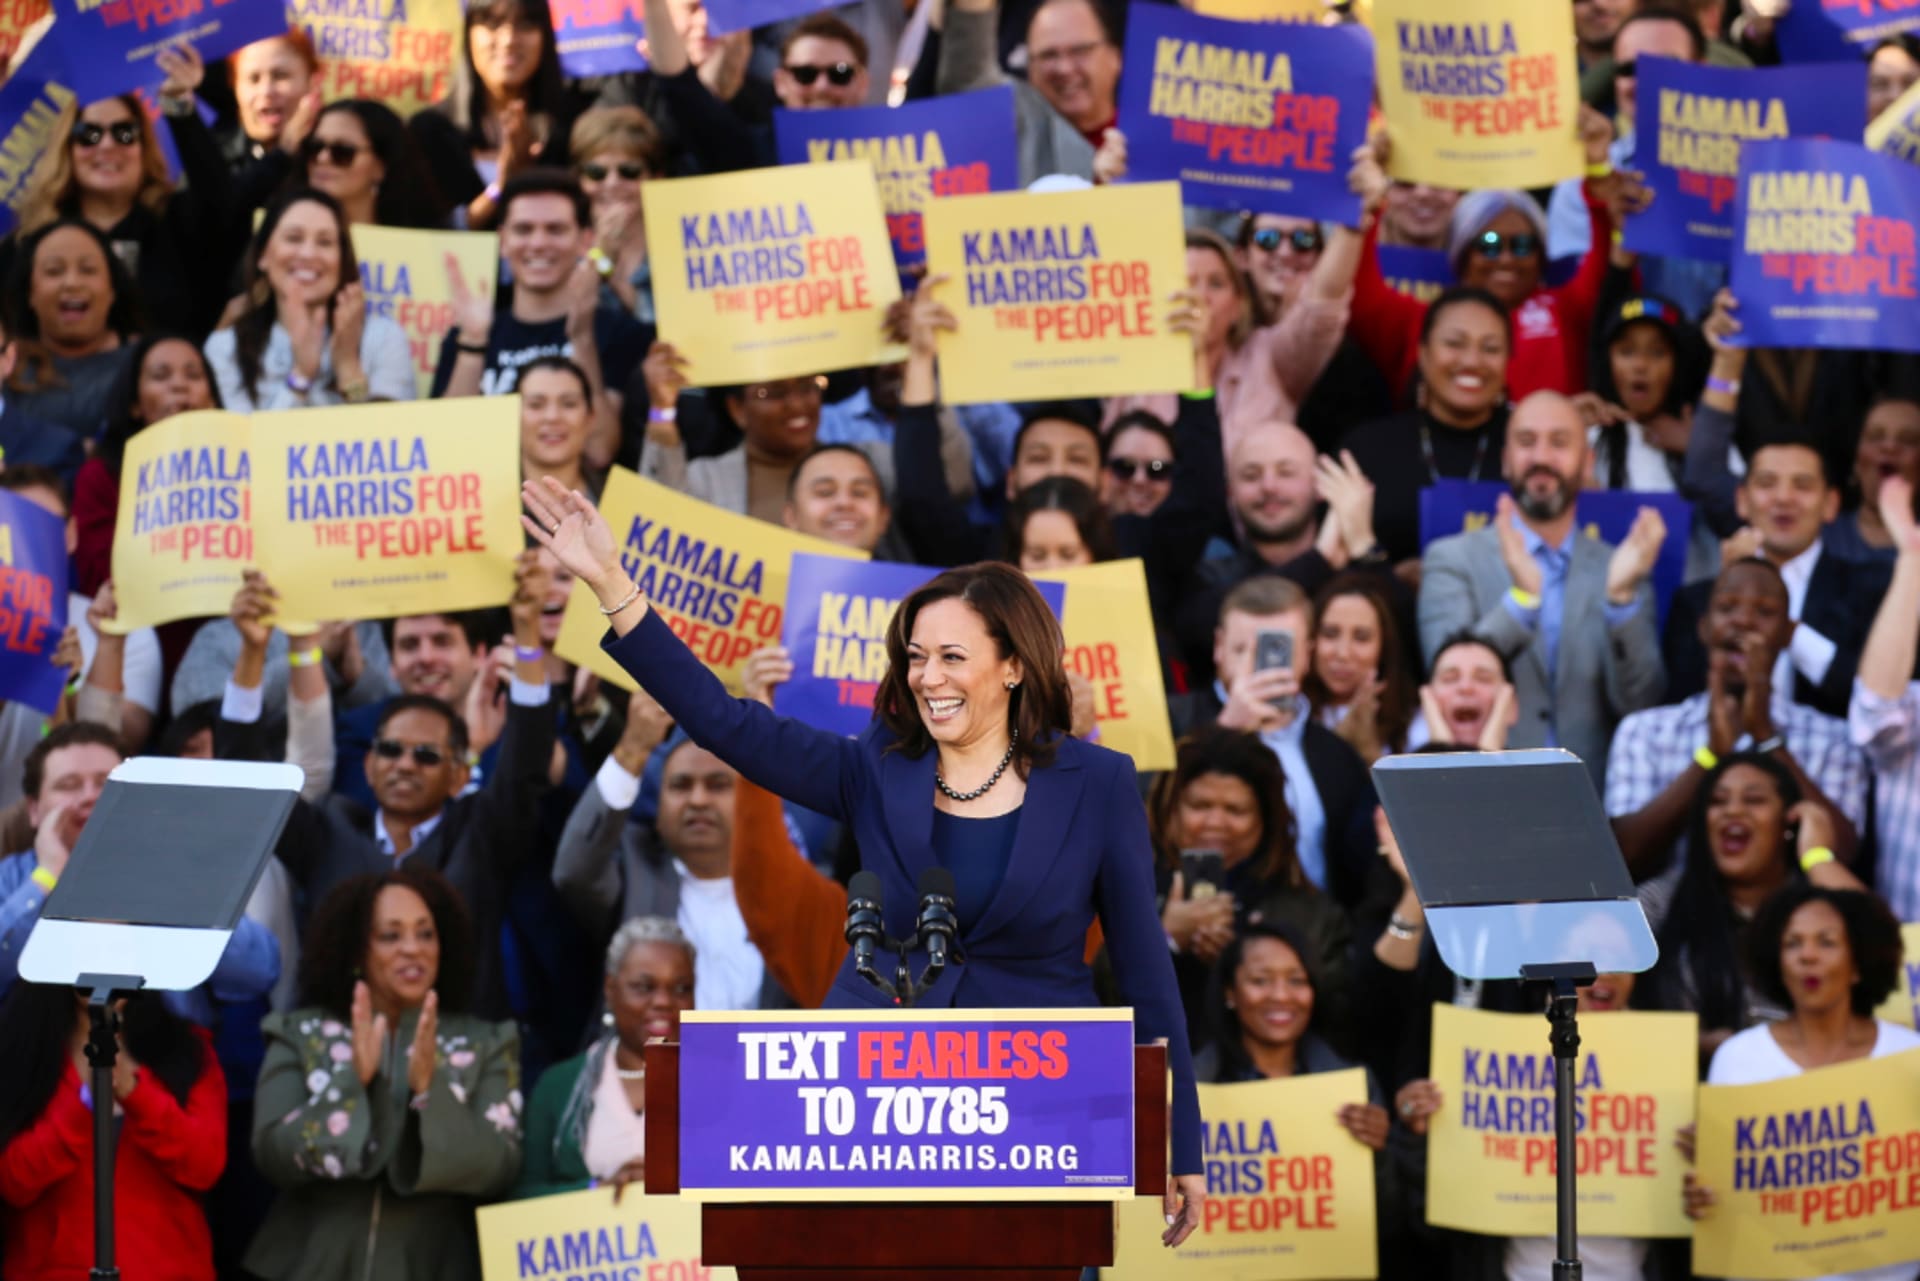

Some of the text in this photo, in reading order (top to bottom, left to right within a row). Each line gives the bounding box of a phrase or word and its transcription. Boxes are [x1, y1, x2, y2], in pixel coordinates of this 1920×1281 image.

[393, 26, 453, 65] FOR
[1397, 20, 1518, 58] KAMALA
[1156, 36, 1294, 95] KAMALA
[1402, 53, 1558, 97] HARRIS FOR
[1150, 77, 1340, 134] HARRIS FOR
[1452, 92, 1562, 137] PEOPLE
[1658, 86, 1789, 140] KAMALA
[1208, 123, 1336, 173] PEOPLE
[1657, 130, 1740, 176] HARR
[1748, 170, 1873, 219] KAMALA
[681, 201, 815, 251] KAMALA
[962, 223, 1099, 267] KAMALA
[1744, 213, 1856, 257] HARRIS
[1856, 215, 1916, 258] FOR
[685, 235, 866, 291] HARRIS FOR
[967, 260, 1151, 306] HARRIS FOR
[1792, 252, 1918, 299] PEOPLE
[712, 273, 873, 325] THE PEOPLE
[993, 299, 1157, 343] THE PEOPLE
[136, 444, 251, 498] KAMALA
[287, 435, 429, 480] KAMALA
[133, 485, 240, 538] HARRIS
[287, 477, 415, 522] HARRIS
[417, 472, 482, 514] FOR
[182, 522, 253, 563] PEO
[312, 513, 487, 560] THE PEOPLE
[626, 513, 765, 597] KAMALA
[620, 551, 784, 640] HARRIS FO
[816, 590, 901, 643] KAM
[667, 613, 765, 669] PEOP
[811, 633, 894, 683] HAR
[738, 1030, 1069, 1080] TEXT FEARLESS
[1463, 1048, 1603, 1091] KAMAA
[797, 1085, 1009, 1136] TO 70785
[1589, 1093, 1658, 1134] FOR
[1736, 1097, 1876, 1152] KAMALA
[729, 1144, 1079, 1172] KAMALAHARRIS.ORG
[1482, 1135, 1519, 1161] THE
[1734, 1130, 1920, 1192] HARRIS FOR
[1205, 1154, 1335, 1195] RIS FOR
[1760, 1171, 1920, 1227] THE PEOPLE
[1202, 1195, 1337, 1235] PEOPLE
[516, 1220, 658, 1279] KAMALA
